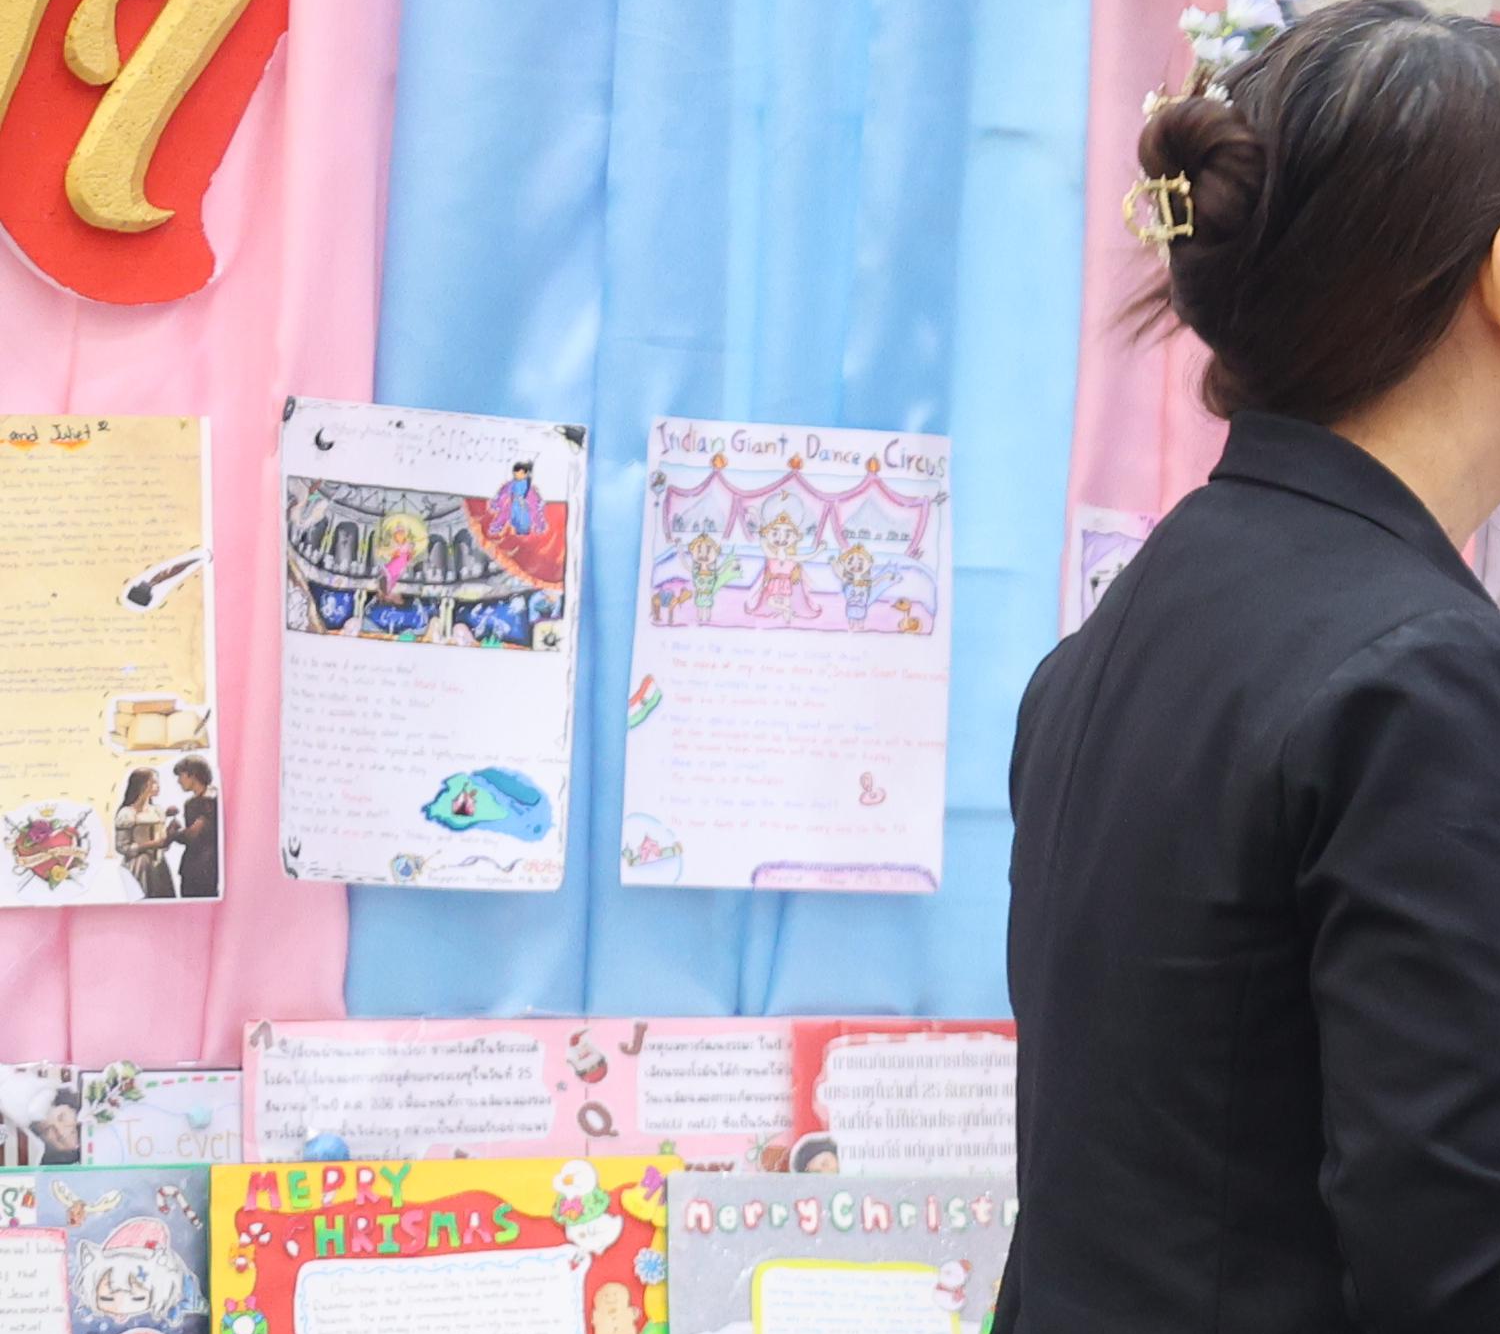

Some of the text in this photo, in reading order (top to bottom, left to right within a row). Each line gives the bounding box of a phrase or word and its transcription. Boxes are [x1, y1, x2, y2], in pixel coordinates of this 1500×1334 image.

[50, 423, 92, 442] Juliet
[656, 421, 947, 478] Indian Giant Dance Circus
